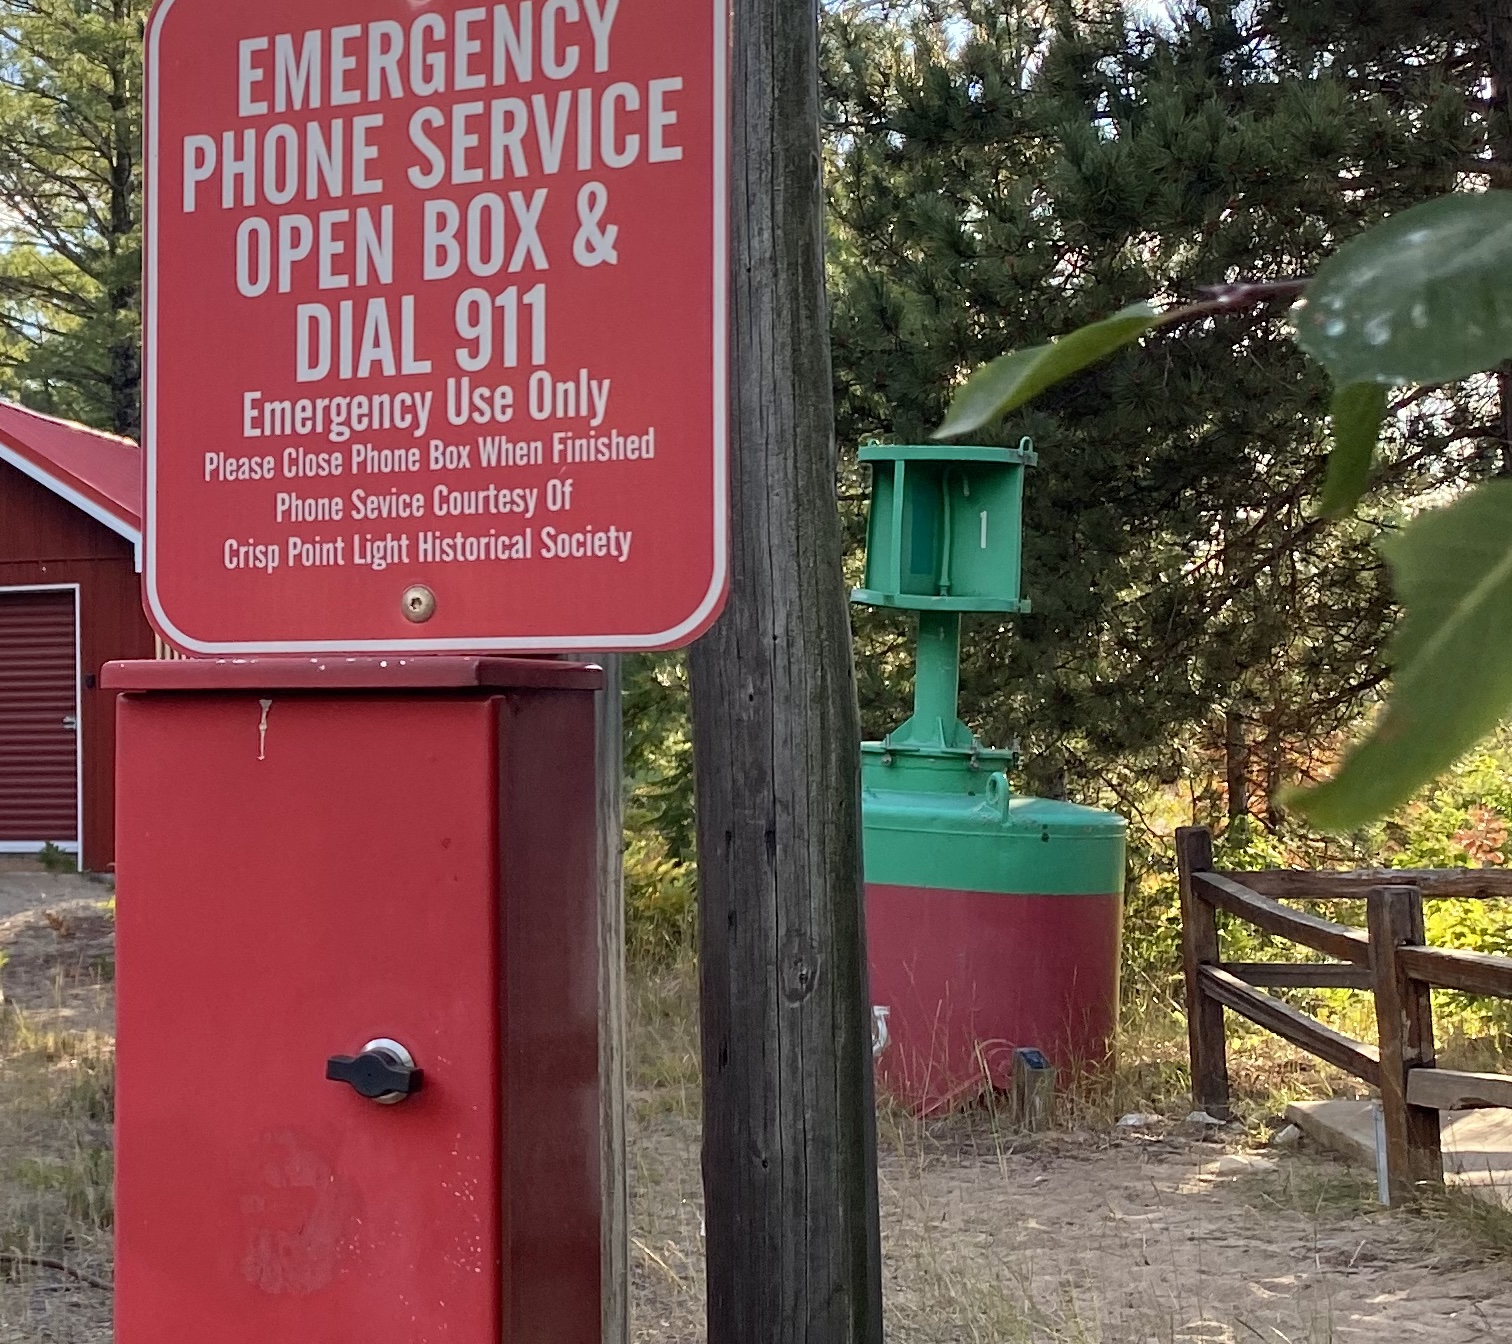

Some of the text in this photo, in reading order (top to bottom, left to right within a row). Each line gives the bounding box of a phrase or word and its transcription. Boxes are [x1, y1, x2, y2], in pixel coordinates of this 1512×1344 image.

[184, 77, 682, 212] PHONE SERVICE
[237, 182, 618, 297] OPEN BOX &
[297, 284, 545, 382] DIAL 911
[244, 369, 610, 442] Emergency Use Only
[205, 427, 654, 481] Please Close Phone Box When Finished
[277, 479, 573, 522] Phone Sevice Courtesy Of
[225, 526, 632, 573] Crisp Point Light Historical Society
